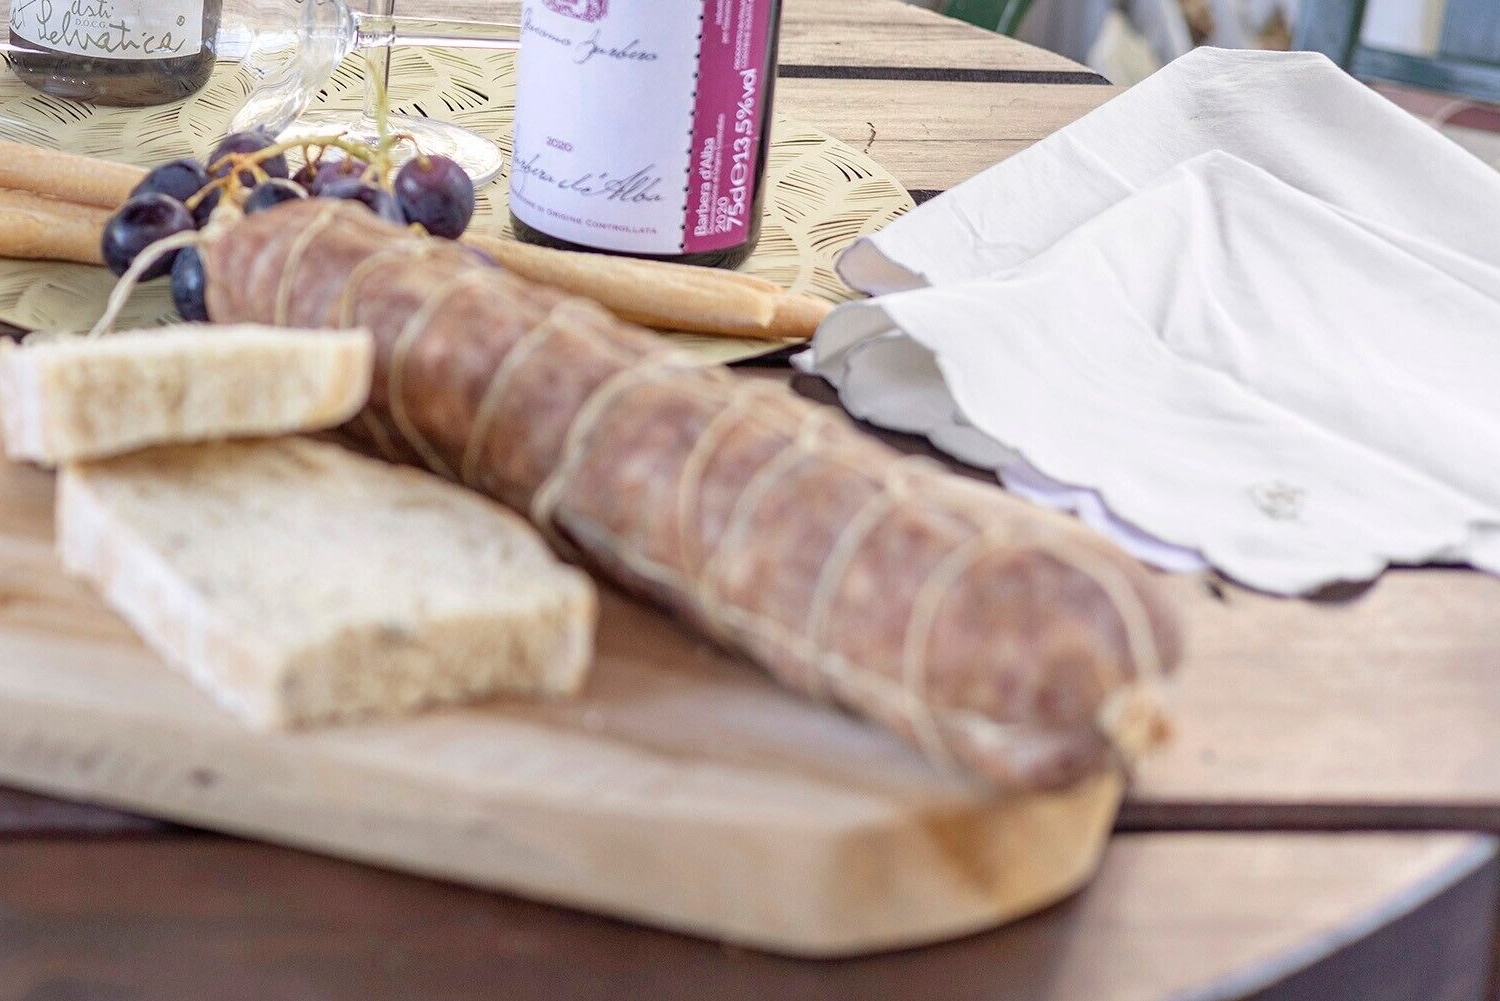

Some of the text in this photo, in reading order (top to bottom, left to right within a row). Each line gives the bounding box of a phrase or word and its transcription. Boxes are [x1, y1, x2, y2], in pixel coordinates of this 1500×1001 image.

[75, 18, 109, 29] D.O.C.G.
[546, 136, 573, 152] 2020
[694, 182, 712, 237] Barbera
[715, 196, 729, 233] 2020
